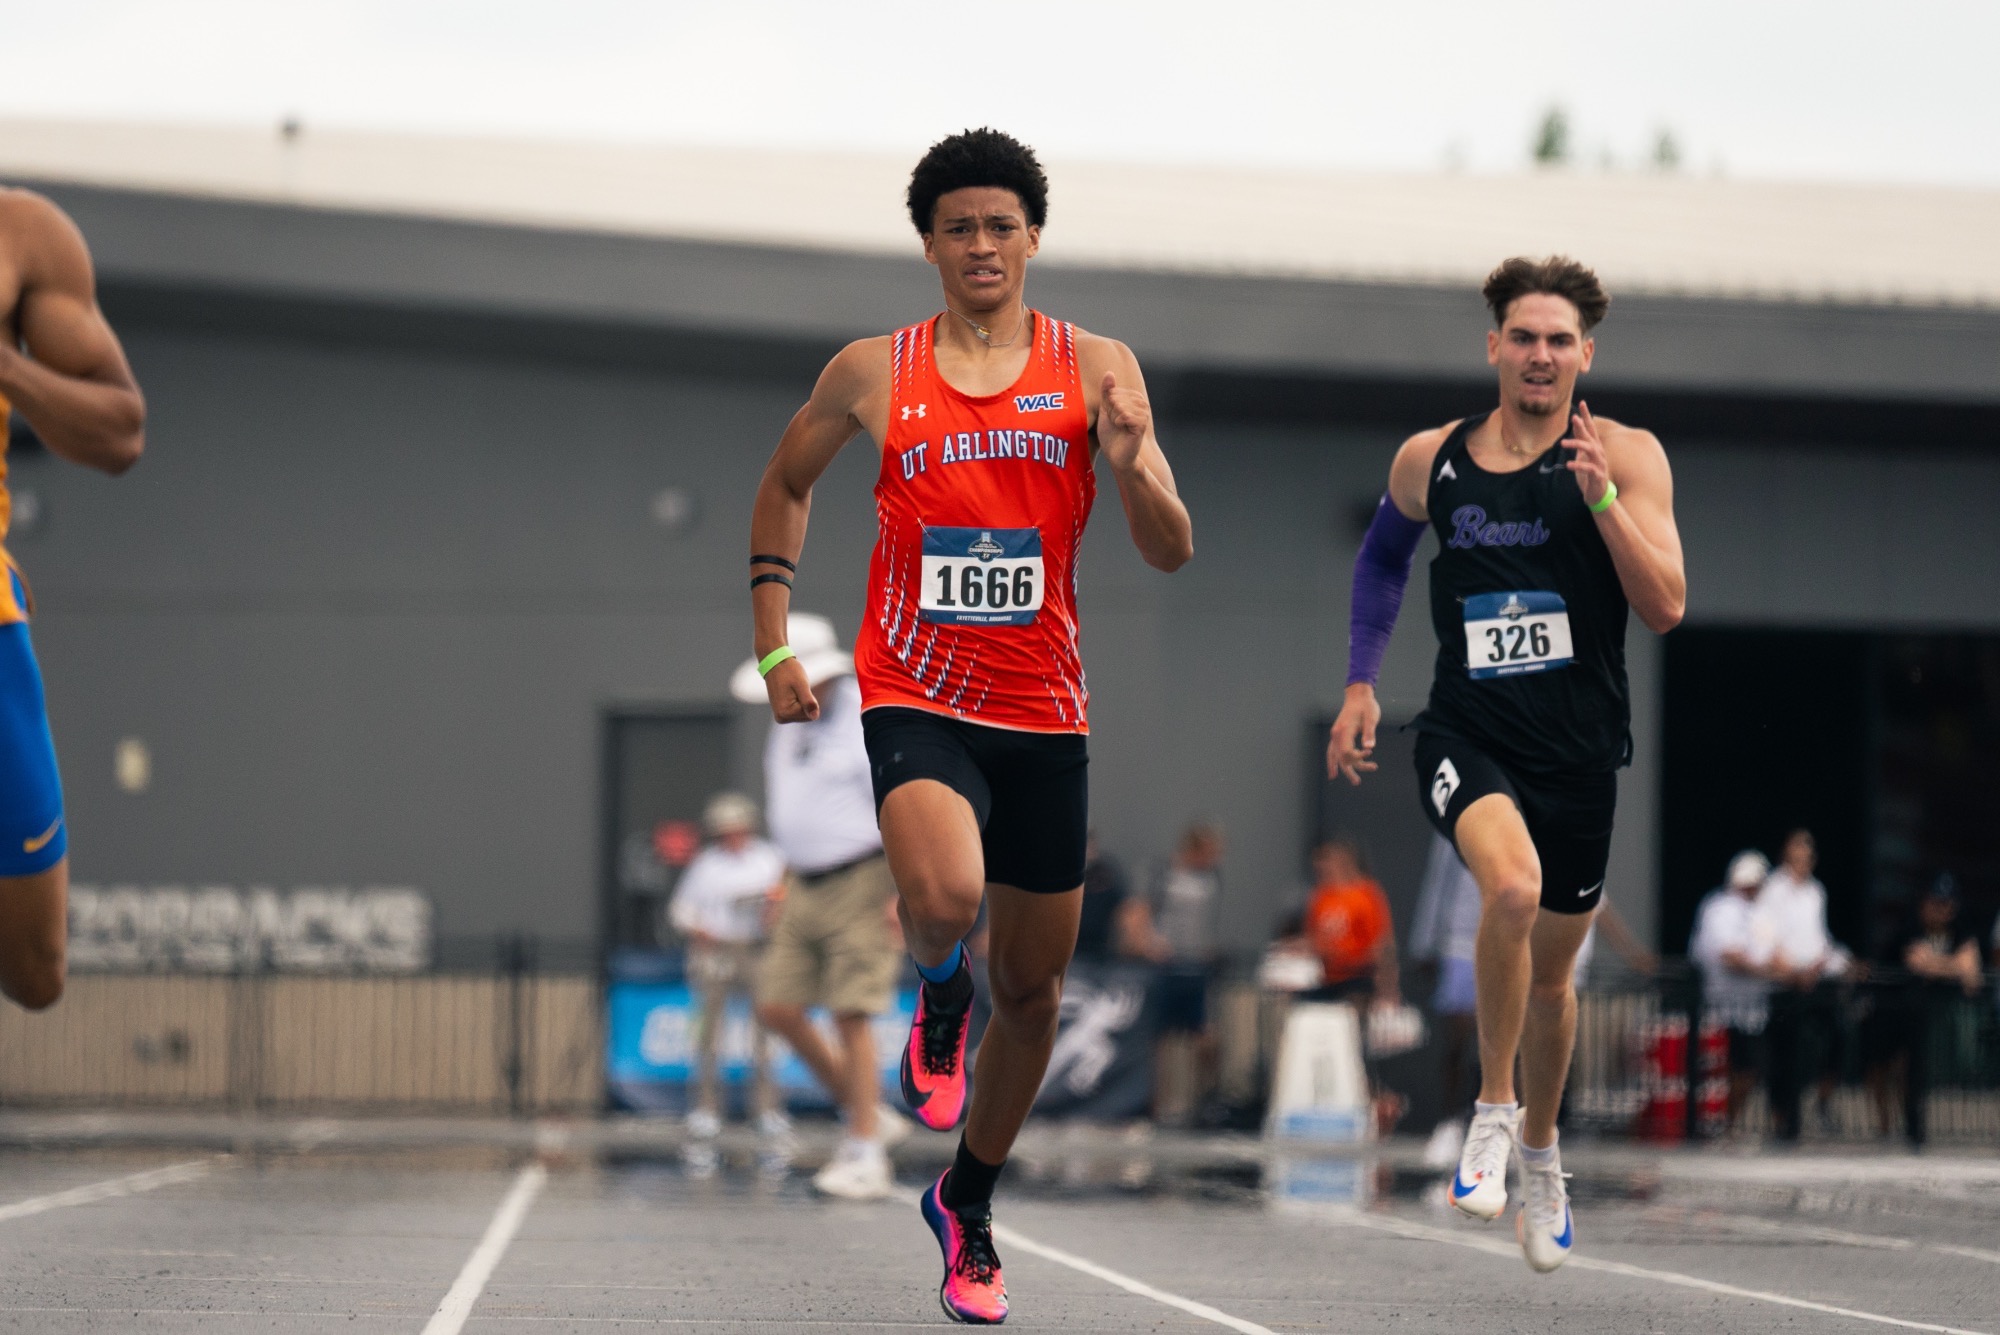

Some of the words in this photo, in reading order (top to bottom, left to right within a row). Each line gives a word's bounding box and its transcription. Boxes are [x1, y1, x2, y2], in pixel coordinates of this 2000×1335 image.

[1014, 392, 1065, 413] WAC
[902, 441, 928, 481] UT
[941, 430, 1069, 469] ARLINGTON
[1448, 504, 1550, 549] Bears
[936, 565, 1034, 608] 1666
[1486, 622, 1551, 662] 326
